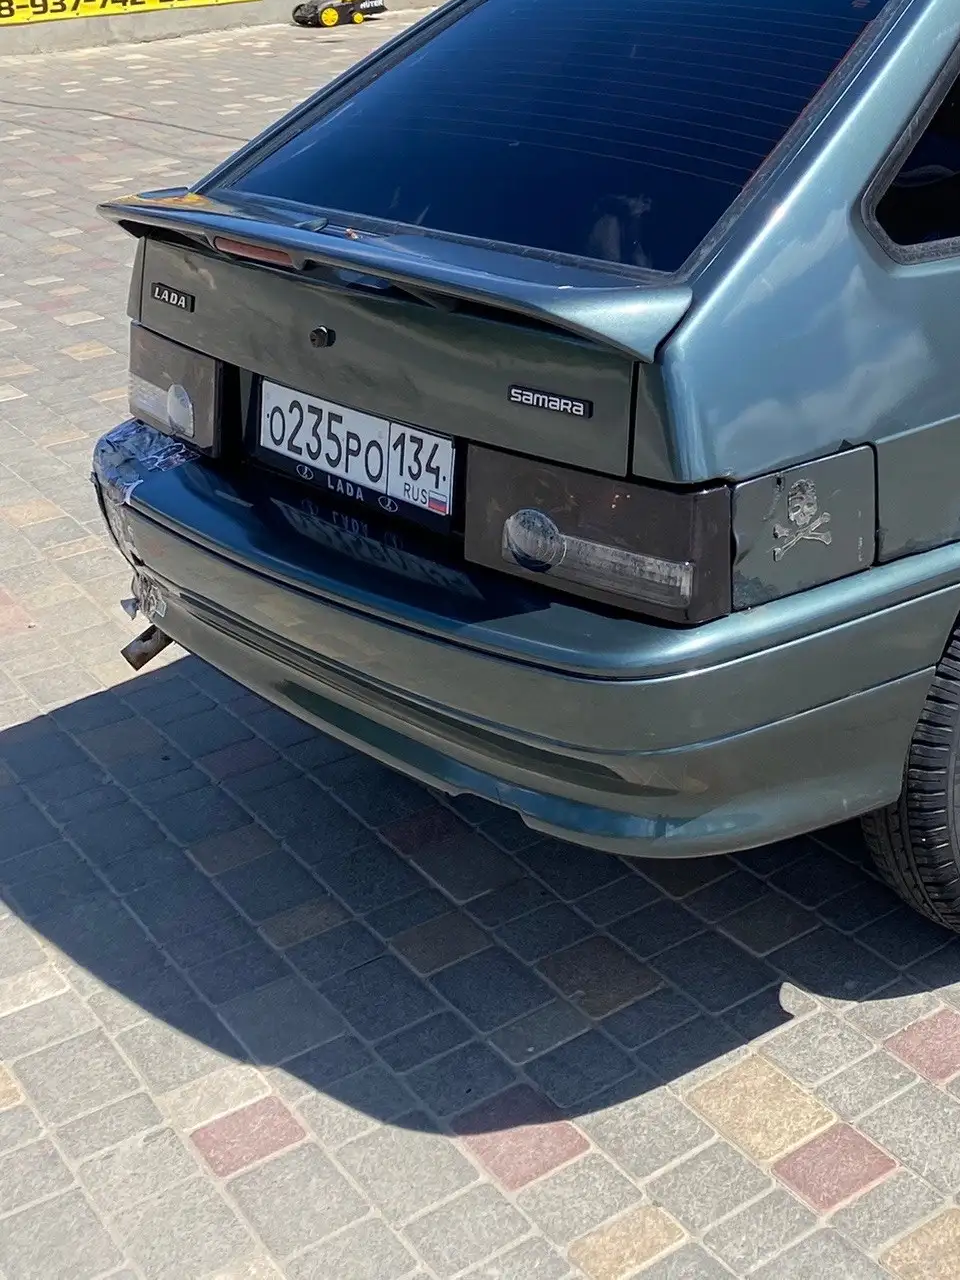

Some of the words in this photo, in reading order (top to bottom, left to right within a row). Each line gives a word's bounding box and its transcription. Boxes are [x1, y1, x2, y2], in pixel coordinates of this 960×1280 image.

[154, 286, 186, 309] LADA
[392, 432, 439, 489] 134
[327, 474, 365, 502] LADA
[403, 482, 428, 505] RUS
